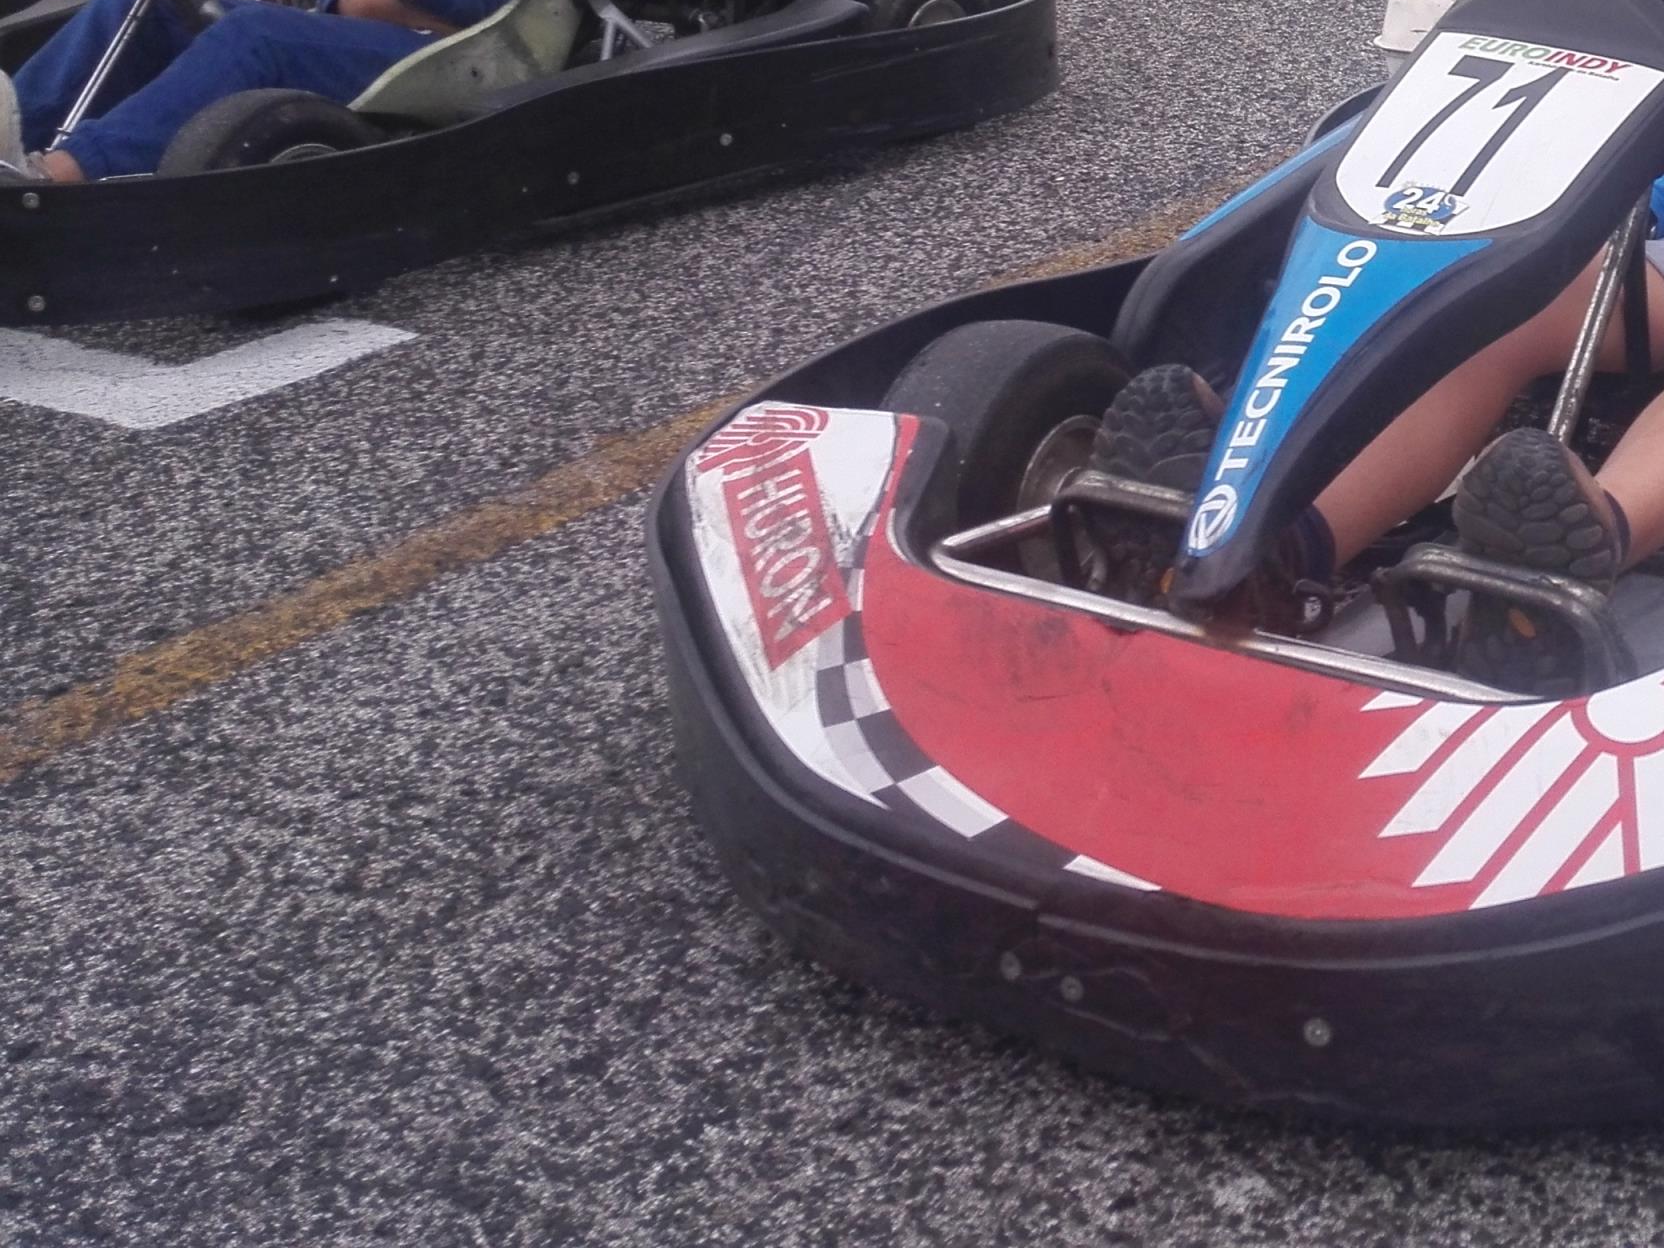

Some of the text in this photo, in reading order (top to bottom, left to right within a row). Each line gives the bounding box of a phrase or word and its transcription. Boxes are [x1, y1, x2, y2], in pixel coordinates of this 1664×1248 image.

[1374, 54, 1572, 197] 71
[1458, 36, 1632, 74] EUROINDY
[1216, 238, 1381, 481] TECNIROLO
[737, 466, 834, 643] HURON
